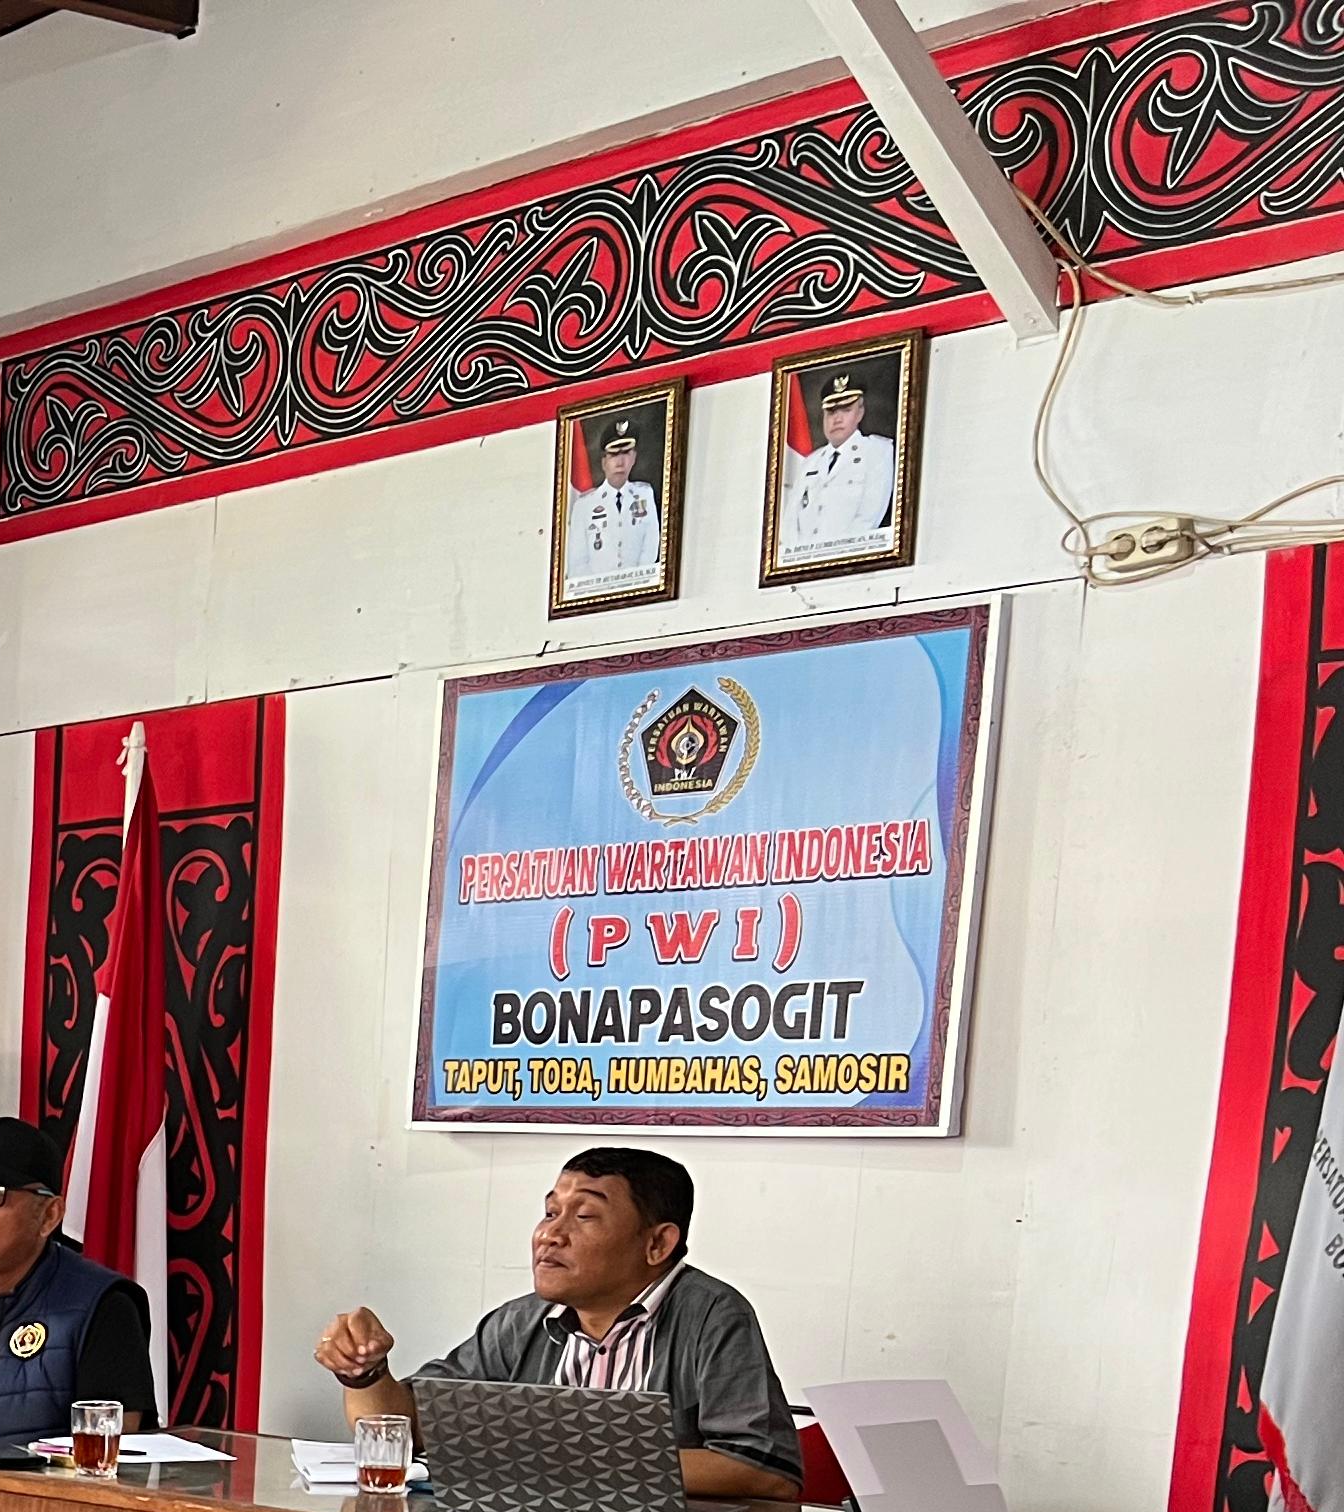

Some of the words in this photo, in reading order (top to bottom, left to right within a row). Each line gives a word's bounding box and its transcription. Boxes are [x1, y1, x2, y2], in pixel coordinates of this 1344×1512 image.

[648, 703, 689, 760] PERSATUAN
[694, 702, 728, 752] WARTAWAN
[654, 779, 713, 792] INDONESIA
[460, 845, 600, 904] PERSATUAN
[603, 832, 770, 893] WARTAWAN
[770, 818, 932, 885] INDONESIA
[492, 980, 863, 1045] BONAPASOGIT
[443, 1058, 523, 1101] TAPUT,
[527, 1058, 601, 1101] TOBA,
[607, 1055, 768, 1101] HUMBAHAS,
[774, 1053, 910, 1093] SAMOSIR
